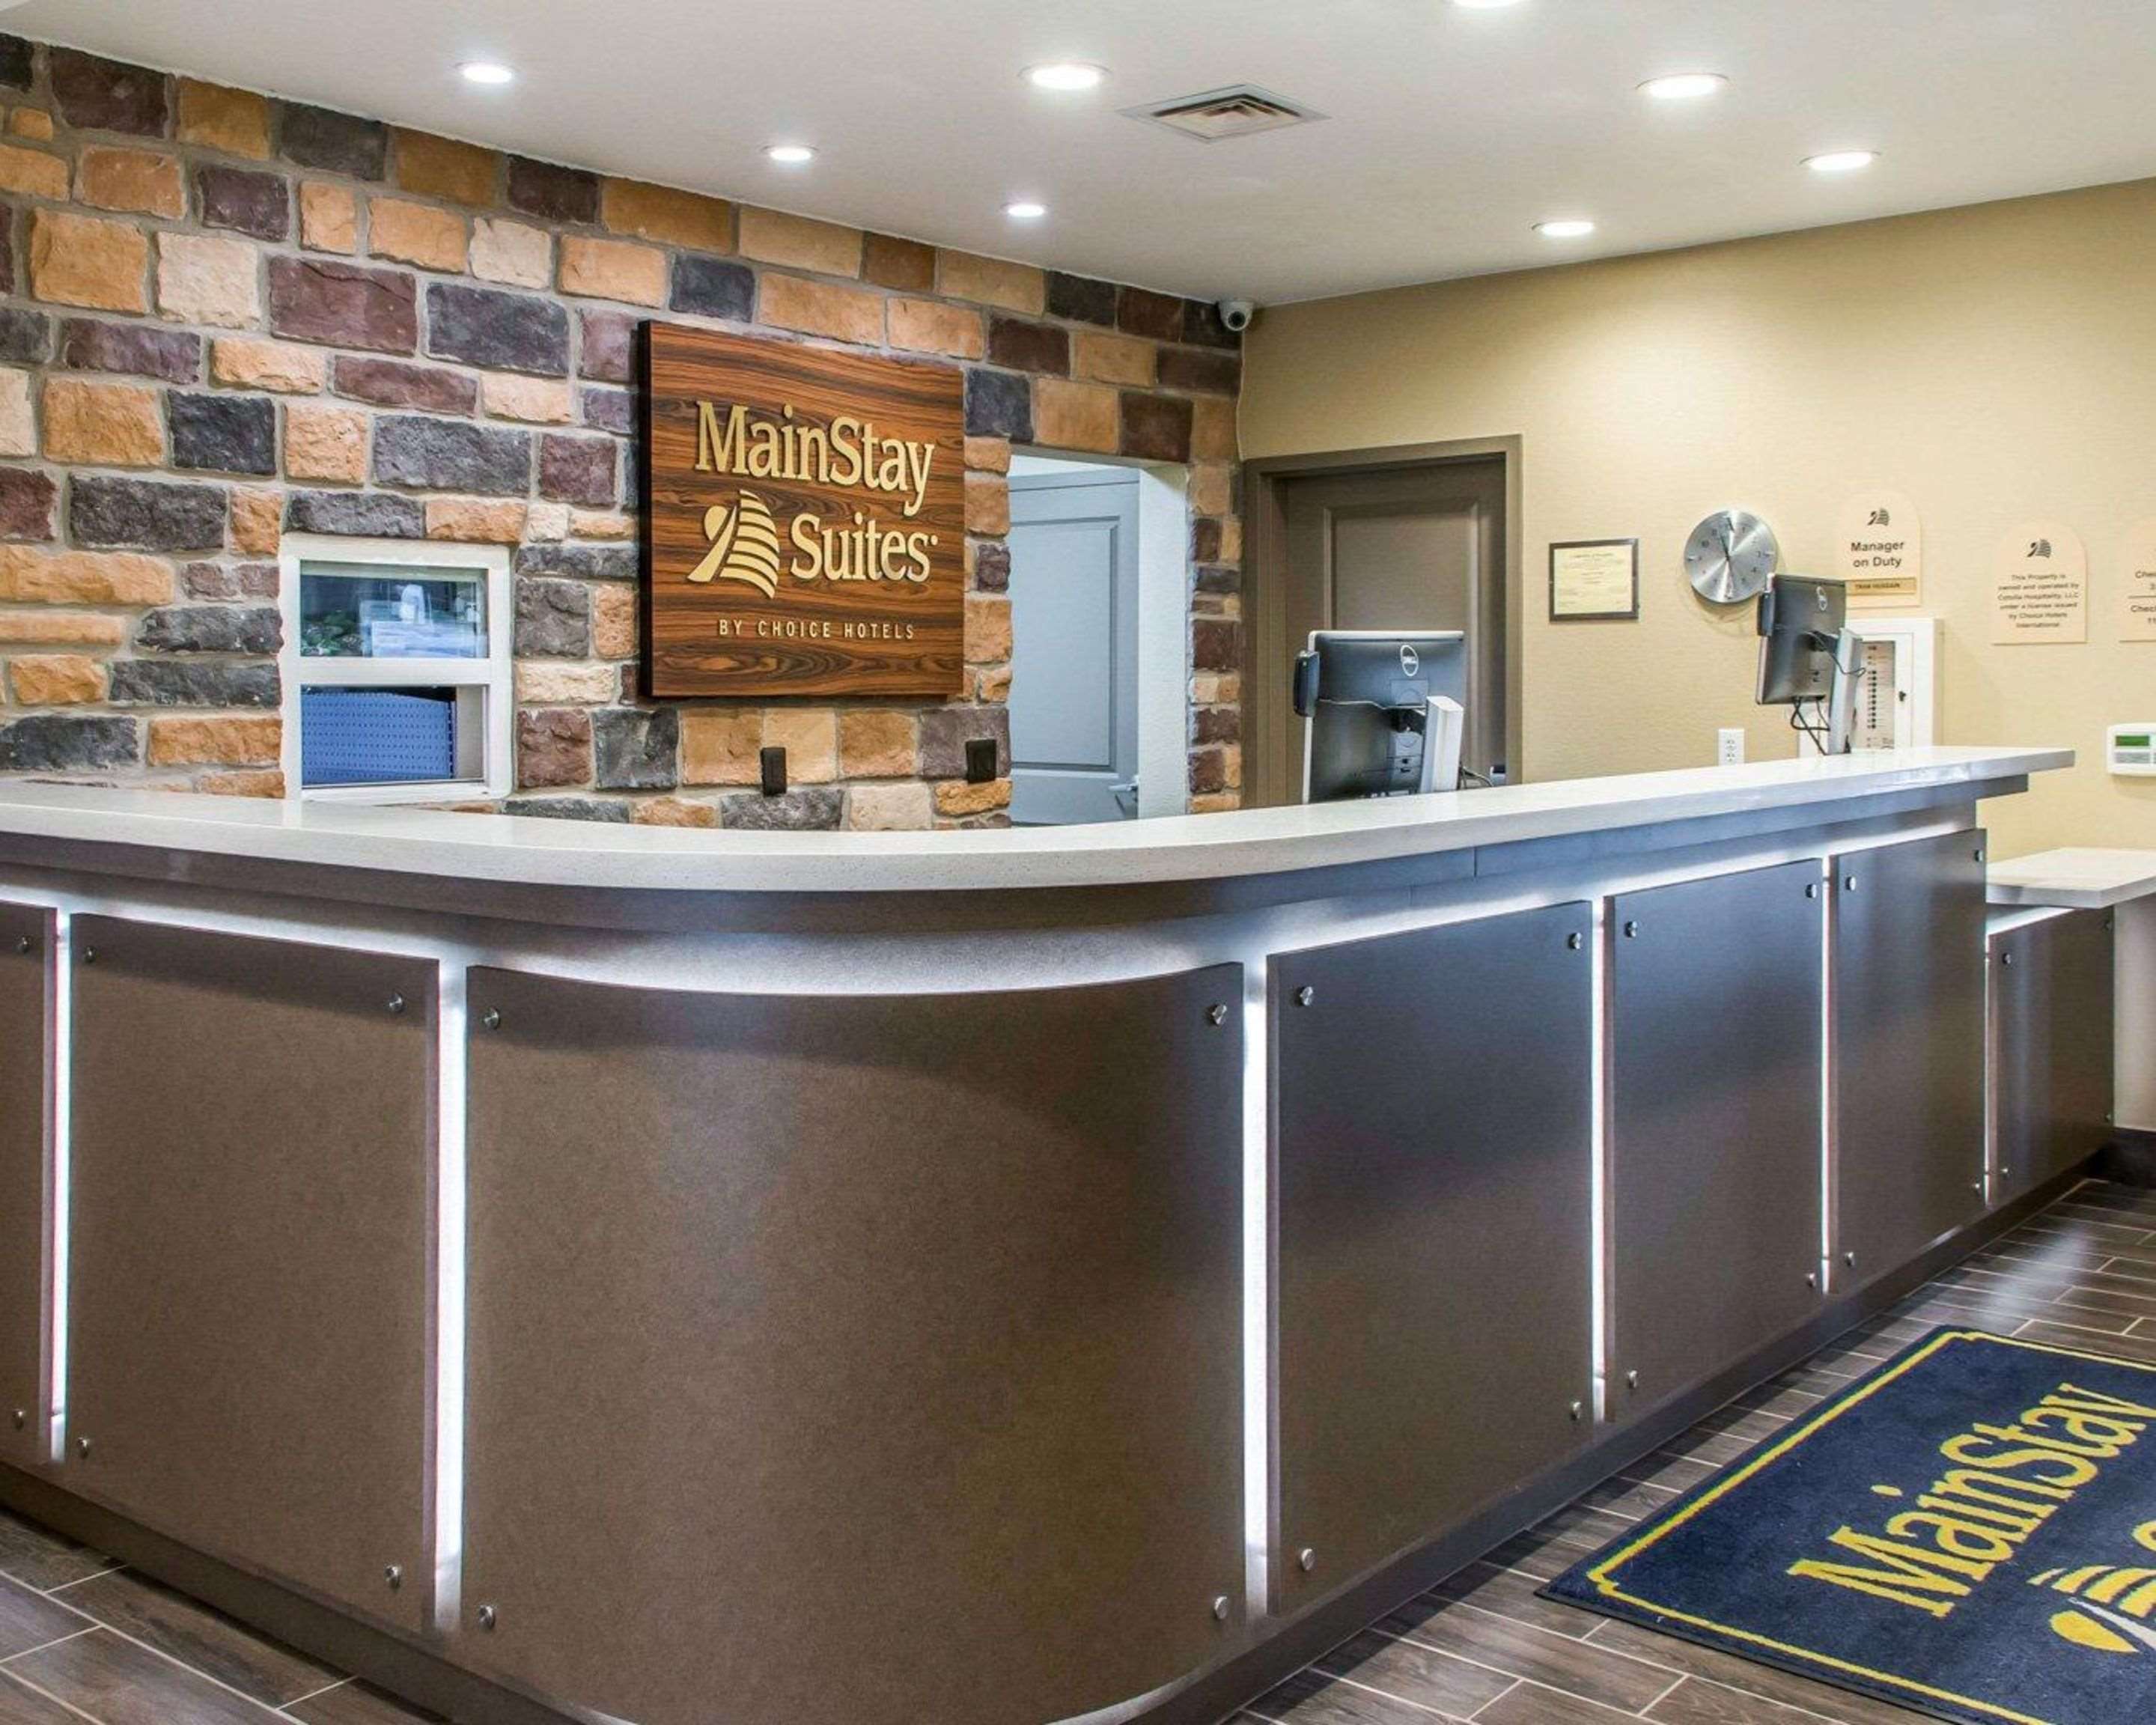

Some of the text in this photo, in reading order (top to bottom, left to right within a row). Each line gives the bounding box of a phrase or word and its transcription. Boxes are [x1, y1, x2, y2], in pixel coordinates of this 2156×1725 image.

[695, 401, 934, 517] MainStay
[790, 511, 932, 582] Suites
[1851, 541, 1904, 553] Manager
[1853, 556, 1901, 568] on Duty
[719, 619, 914, 639] BY CHOICE HOTELS
